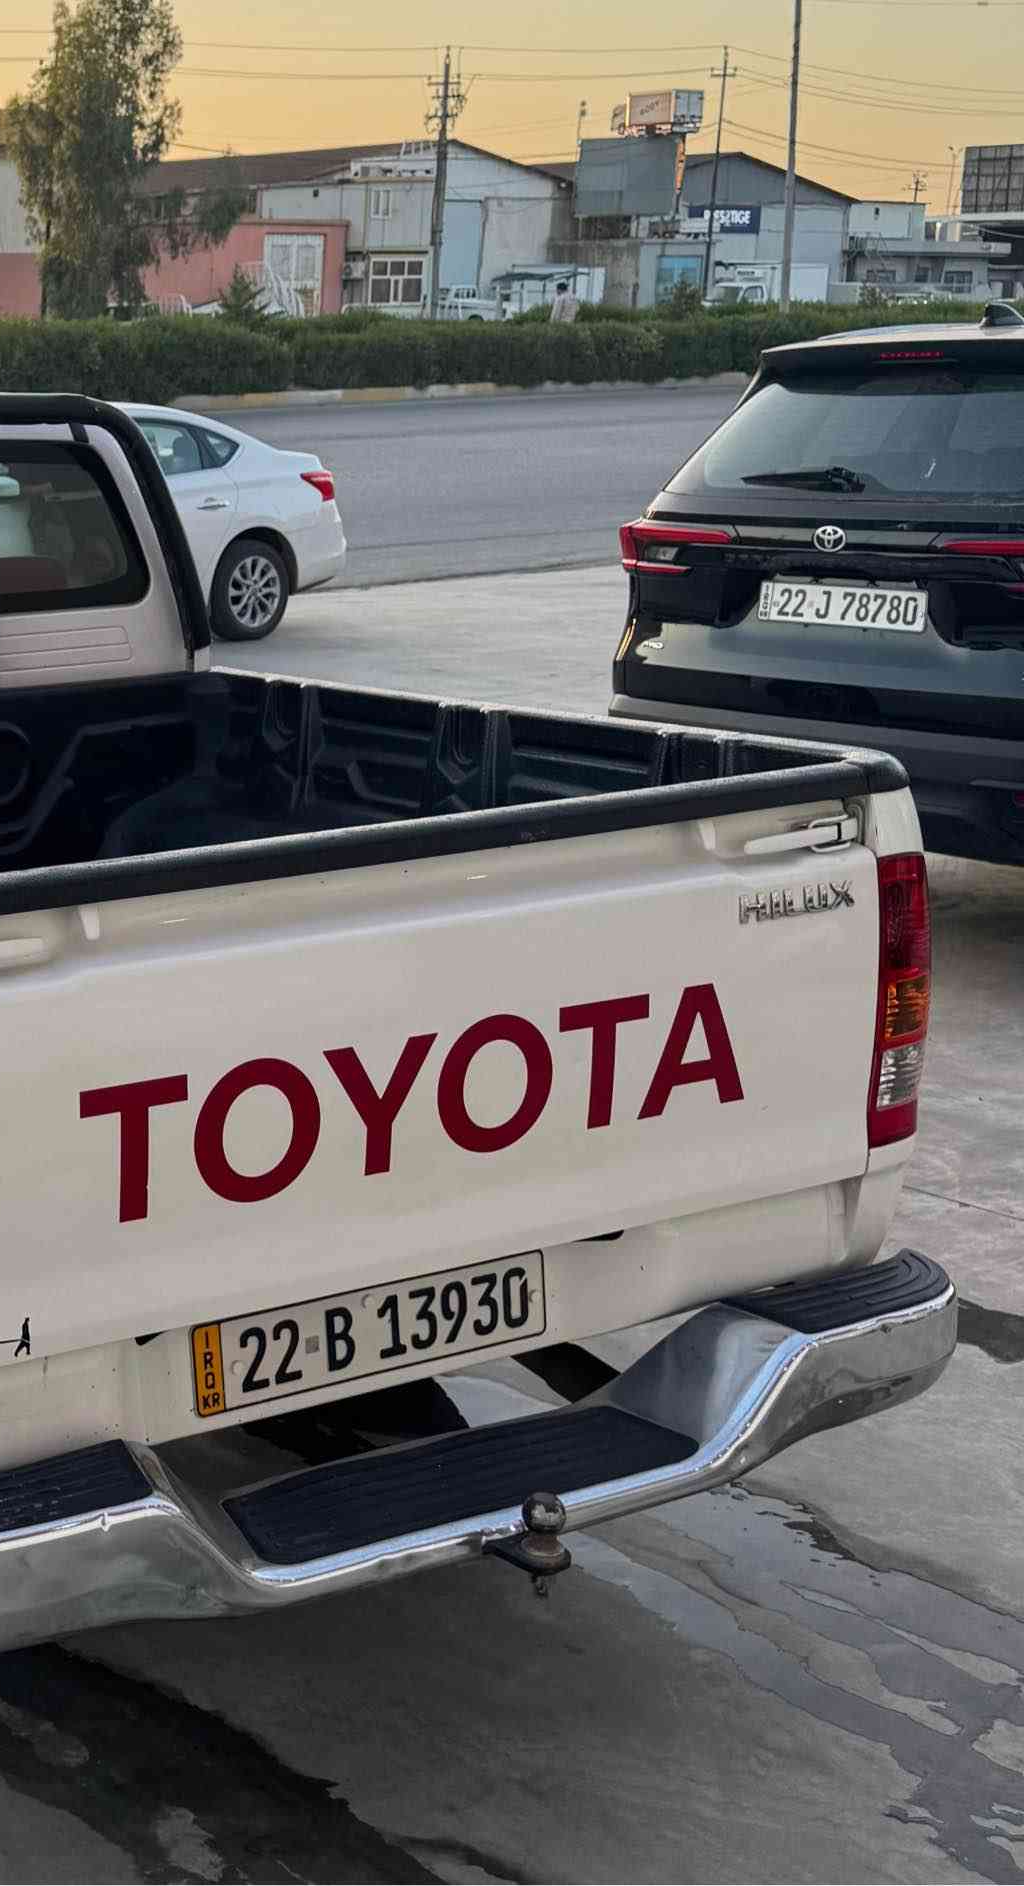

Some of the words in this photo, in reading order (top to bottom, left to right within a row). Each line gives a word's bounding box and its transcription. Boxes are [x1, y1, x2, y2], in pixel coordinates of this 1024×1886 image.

[777, 588, 807, 618] 22
[815, 590, 832, 619] J
[840, 592, 918, 626] 78780
[739, 881, 855, 925] HILUX
[79, 983, 745, 1224] TOYOTA
[239, 1319, 303, 1392] 22
[324, 1307, 356, 1371] B
[377, 1267, 529, 1359] 13930
[202, 1394, 222, 1411] KR
